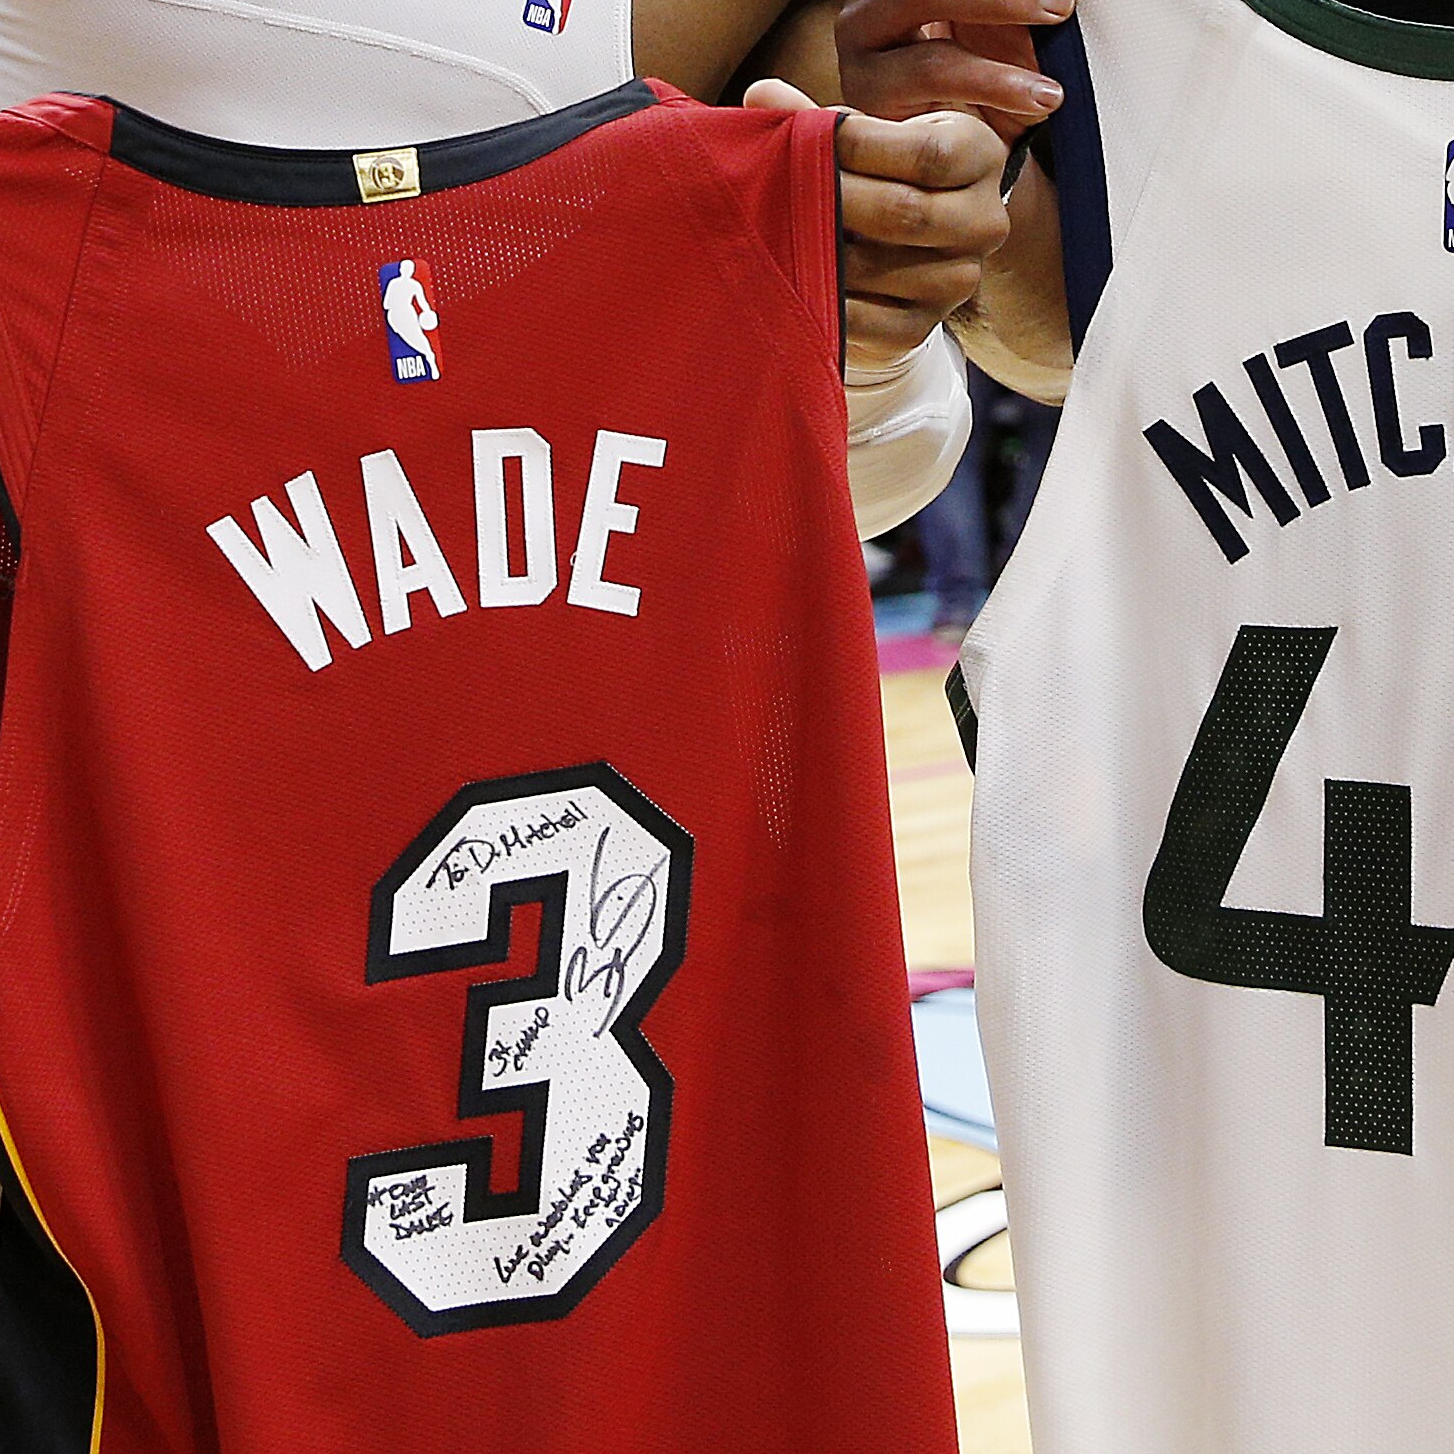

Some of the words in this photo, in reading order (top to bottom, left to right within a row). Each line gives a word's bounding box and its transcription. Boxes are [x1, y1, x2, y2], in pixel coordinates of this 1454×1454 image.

[526, 3, 552, 28] NBA
[396, 355, 426, 379] NBA
[206, 427, 667, 672] WADE
[340, 760, 695, 1339] 3
